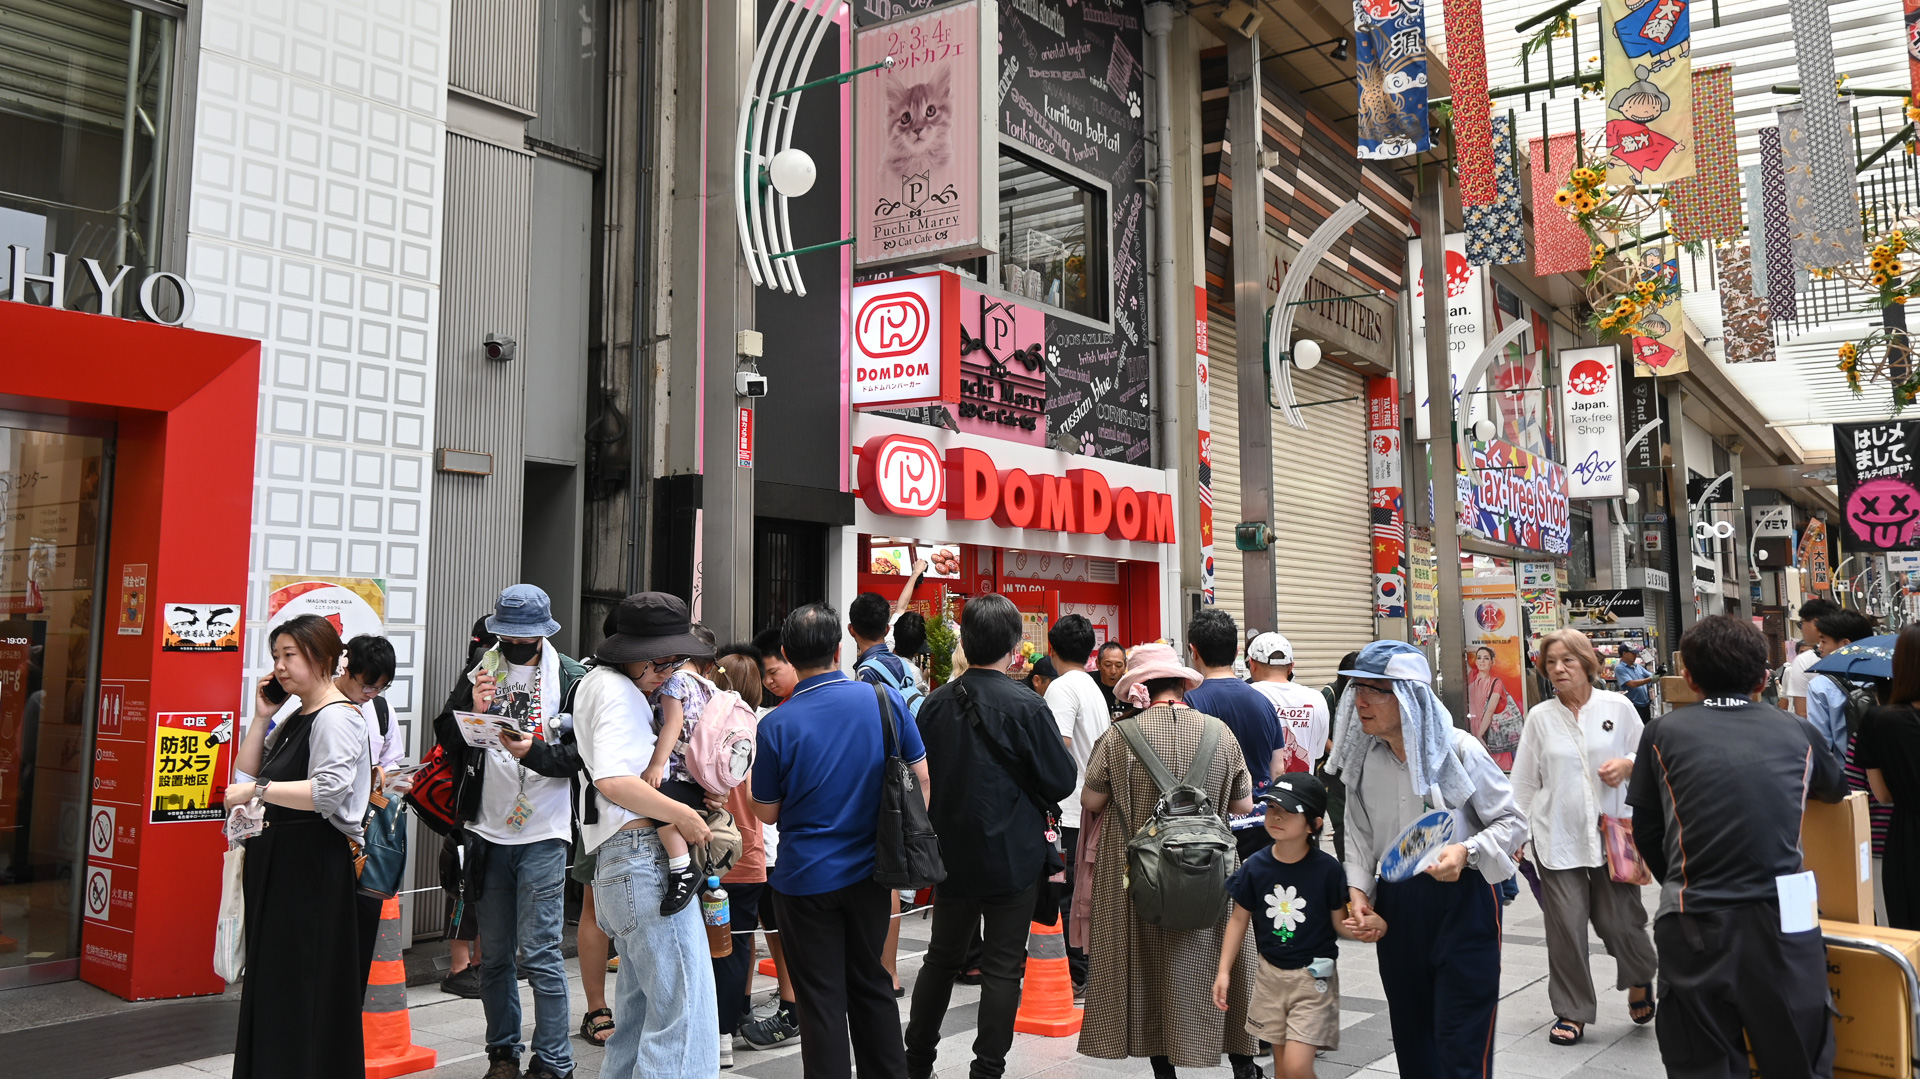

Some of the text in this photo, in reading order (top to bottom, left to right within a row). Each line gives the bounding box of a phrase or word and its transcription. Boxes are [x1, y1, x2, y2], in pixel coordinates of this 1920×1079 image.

[1081, 2, 1139, 32] himalayan
[888, 19, 952, 57] 2F 3F 4F
[1027, 67, 1087, 81] bengal
[1005, 111, 1056, 155] tonkinese
[1044, 94, 1120, 154] kurilian bobtail
[1073, 143, 1099, 162] bombay
[909, 182, 923, 203] P
[874, 215, 959, 238] Puchi Marry
[898, 232, 933, 247] Cat Cafe
[1113, 192, 1143, 287] siamese
[1117, 254, 1137, 308] birman
[991, 316, 1008, 350] P
[1114, 306, 1139, 347] sokoke
[1056, 333, 1114, 348] OJOS AZULES
[862, 382, 921, 393] ドムドムハンバーガー
[960, 375, 1047, 412] uchi Marry
[1090, 376, 1112, 403] blue
[977, 404, 996, 422] Cat
[1060, 396, 1093, 433] russian
[1096, 402, 1132, 427] CORNISH
[1571, 401, 1609, 411] Japan.
[1384, 411, 1392, 426] FREE
[1569, 413, 1613, 424] Tax-free
[1578, 425, 1605, 435] Shop
[1636, 399, 1650, 467] 2nd SREET
[1854, 422, 1905, 450] はじメ
[1855, 443, 1912, 470] まして、
[1813, 551, 1827, 583] 大黒屋
[1536, 601, 1553, 615] 2F
[1585, 591, 1640, 615] Perfume
[495, 681, 527, 696] Grateful
[183, 716, 208, 727] 中区
[160, 735, 199, 755] 防犯
[159, 755, 211, 773] カメラ
[158, 774, 209, 788] 設置地区
